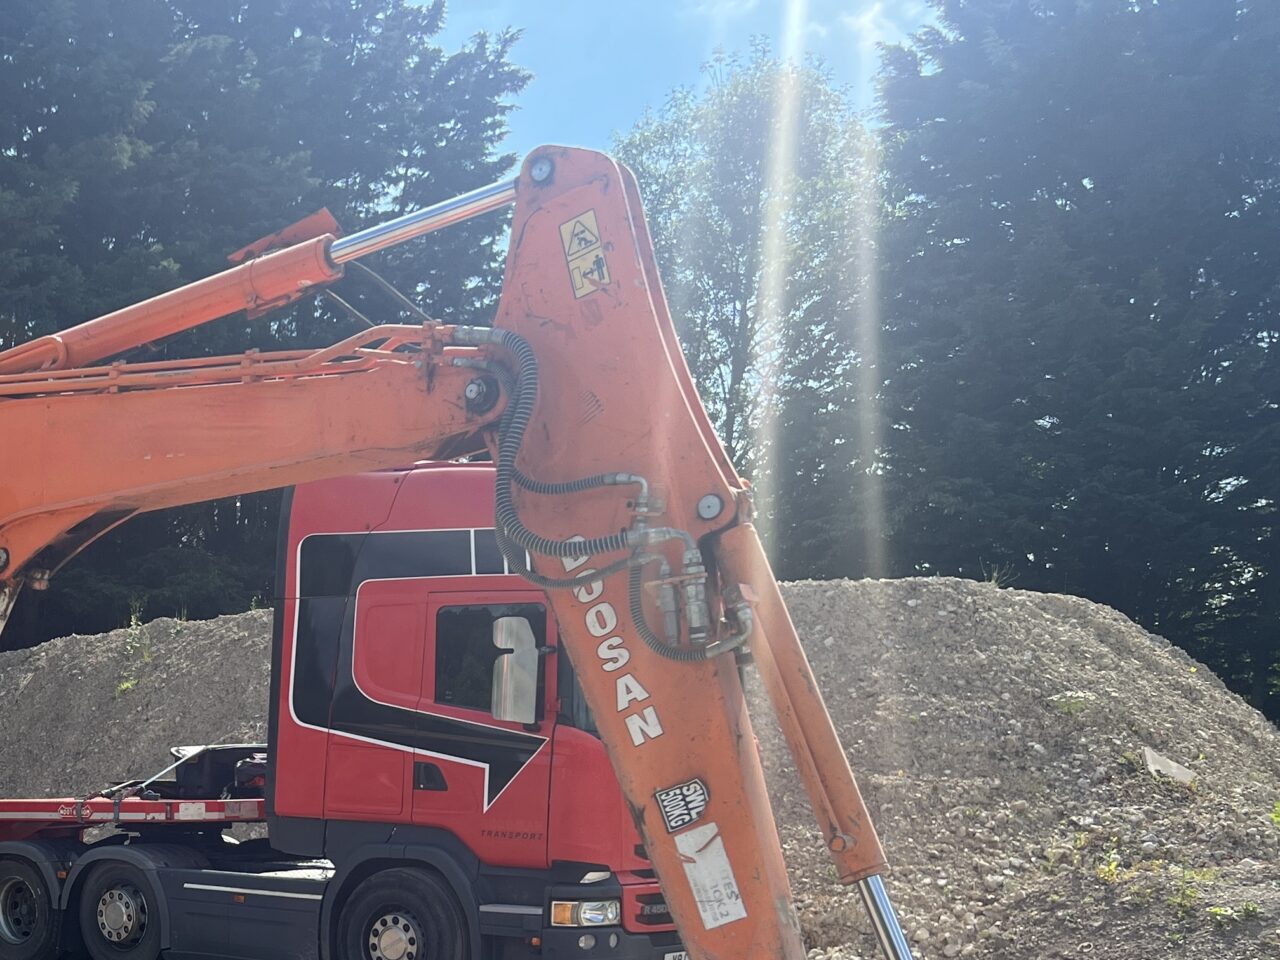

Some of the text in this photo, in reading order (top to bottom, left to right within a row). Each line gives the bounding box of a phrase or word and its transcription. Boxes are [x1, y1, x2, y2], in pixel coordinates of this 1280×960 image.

[561, 535, 664, 748] DOOSAN
[660, 788, 691, 828] 500KG
[682, 783, 706, 820] SWL
[481, 829, 544, 840] TRANSPORT
